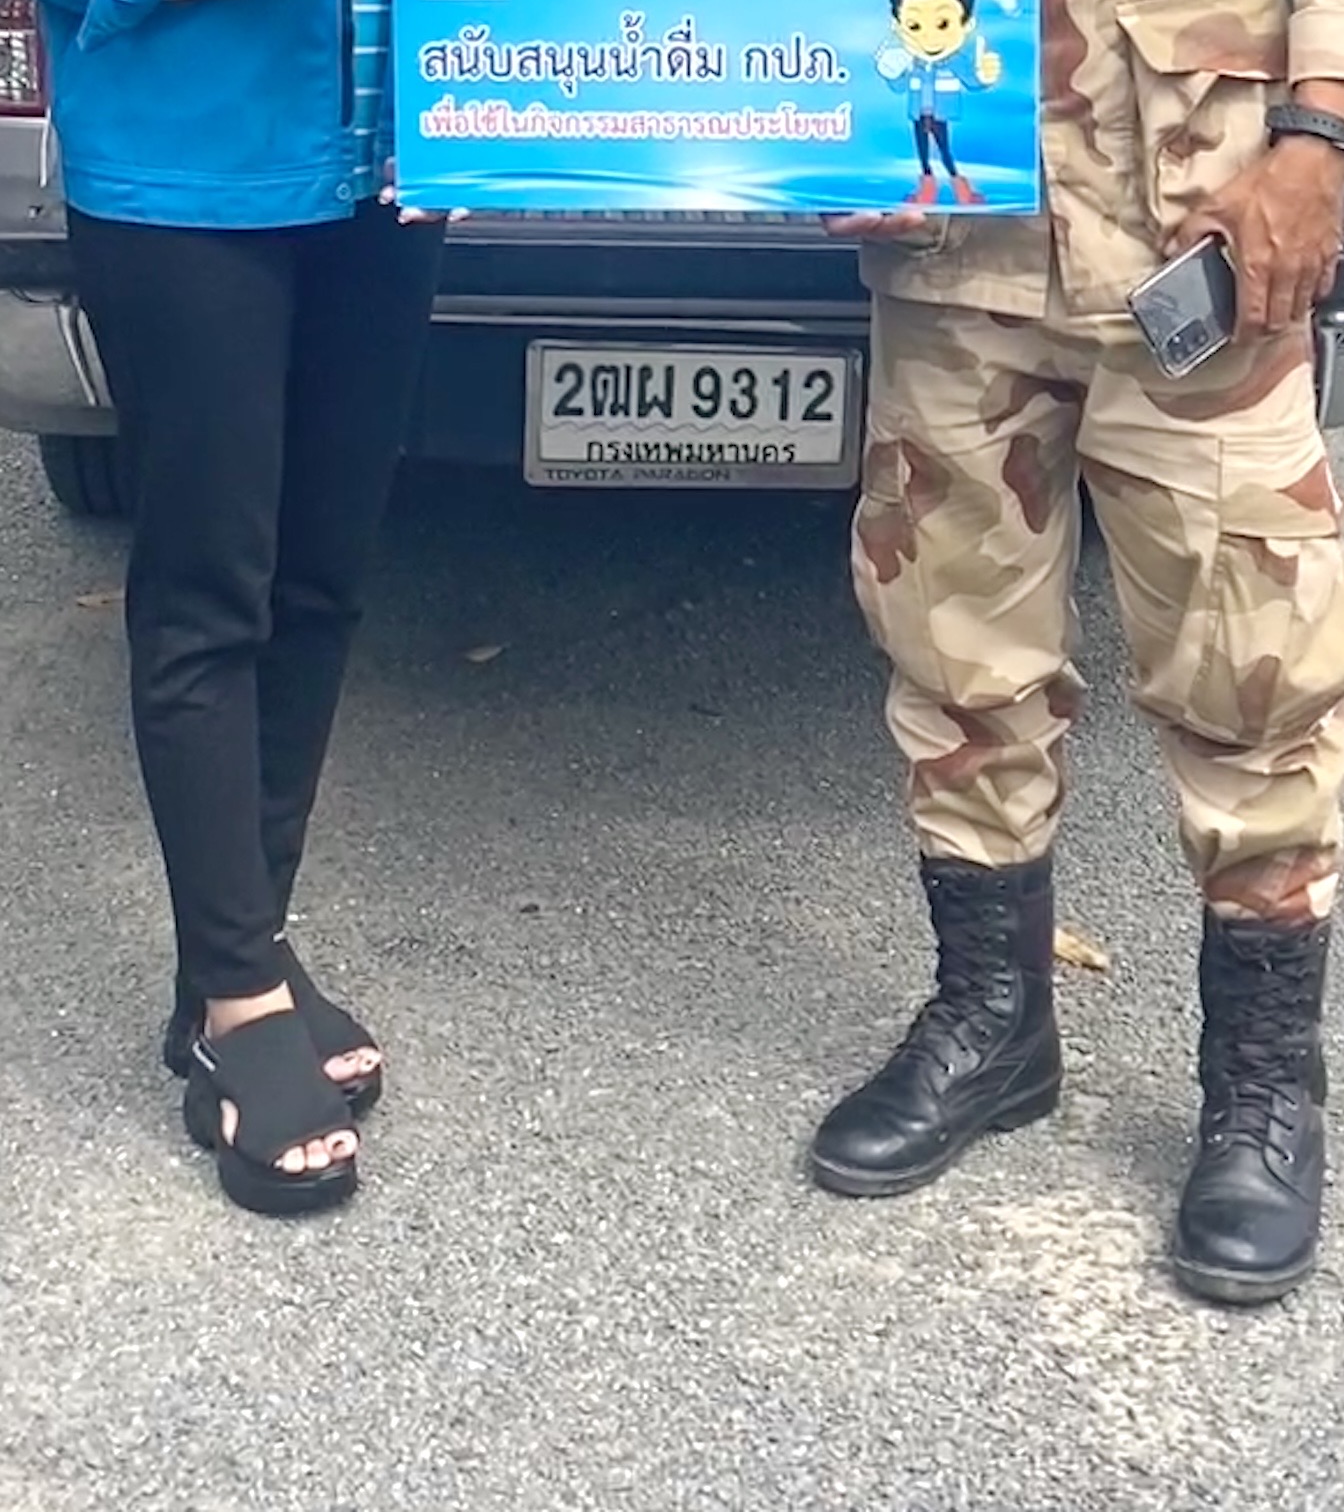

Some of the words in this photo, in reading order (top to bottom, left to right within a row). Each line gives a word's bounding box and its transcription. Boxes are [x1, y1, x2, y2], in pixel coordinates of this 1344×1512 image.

[421, 12, 724, 94] สนับสนุนน้ำดื่ม
[744, 33, 848, 81] กปภ.
[421, 96, 851, 140] เพื่อใช้ในกิจกรรมสาธารณประโยชน์
[691, 366, 835, 422] 9312
[586, 440, 796, 464] กรงเทพมหานคร
[544, 468, 623, 482] TOYOTA
[633, 468, 731, 482] PARAGON
